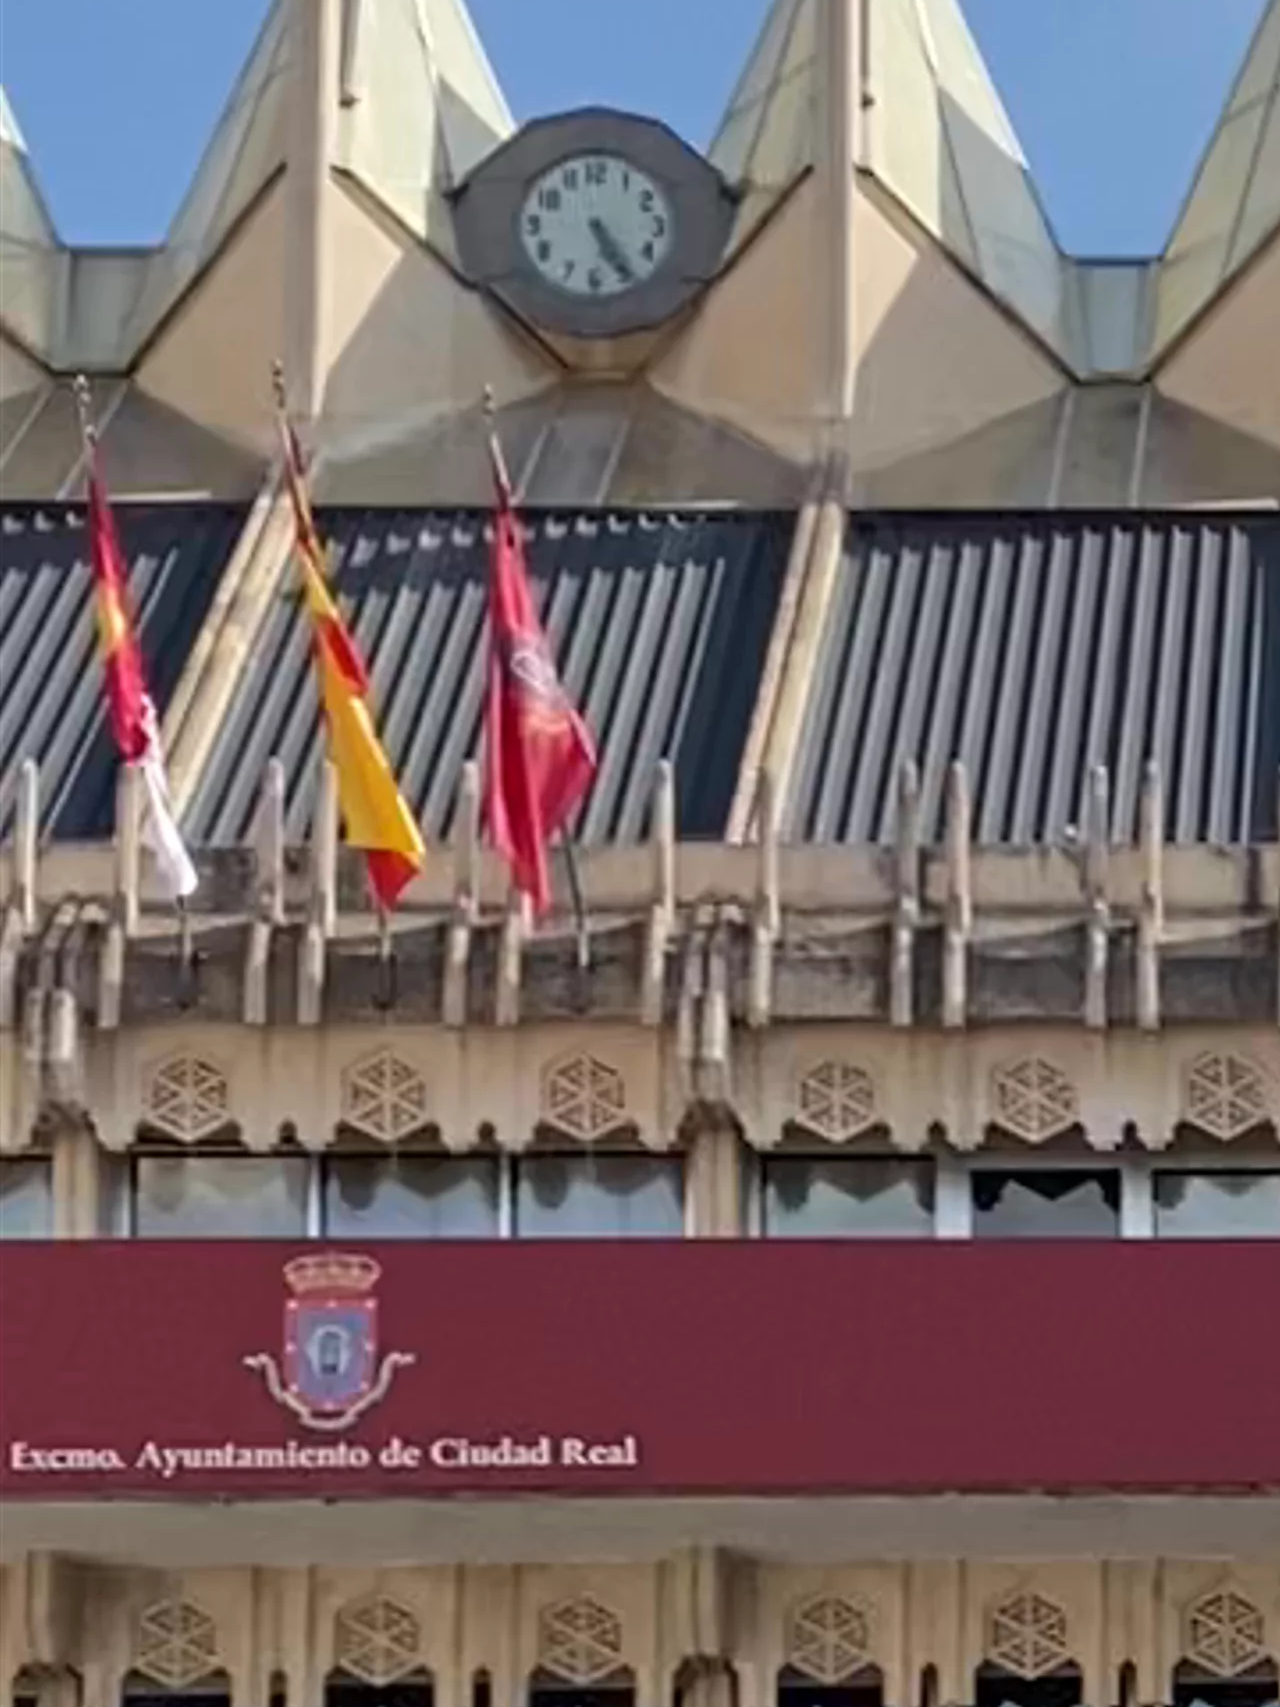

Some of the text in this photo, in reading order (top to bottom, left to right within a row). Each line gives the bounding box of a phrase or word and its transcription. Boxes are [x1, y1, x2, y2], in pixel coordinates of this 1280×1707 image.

[563, 169, 578, 191] 11
[585, 161, 608, 186] 12
[538, 188, 562, 213] 10
[639, 189, 654, 214] 2
[526, 215, 541, 236] 9
[652, 215, 665, 238] 3
[641, 240, 654, 262] 4
[563, 259, 575, 280] 7
[588, 267, 602, 291] 6
[10, 1435, 638, 1479] Excmo. Ayuntamiento de Ciudad Real
